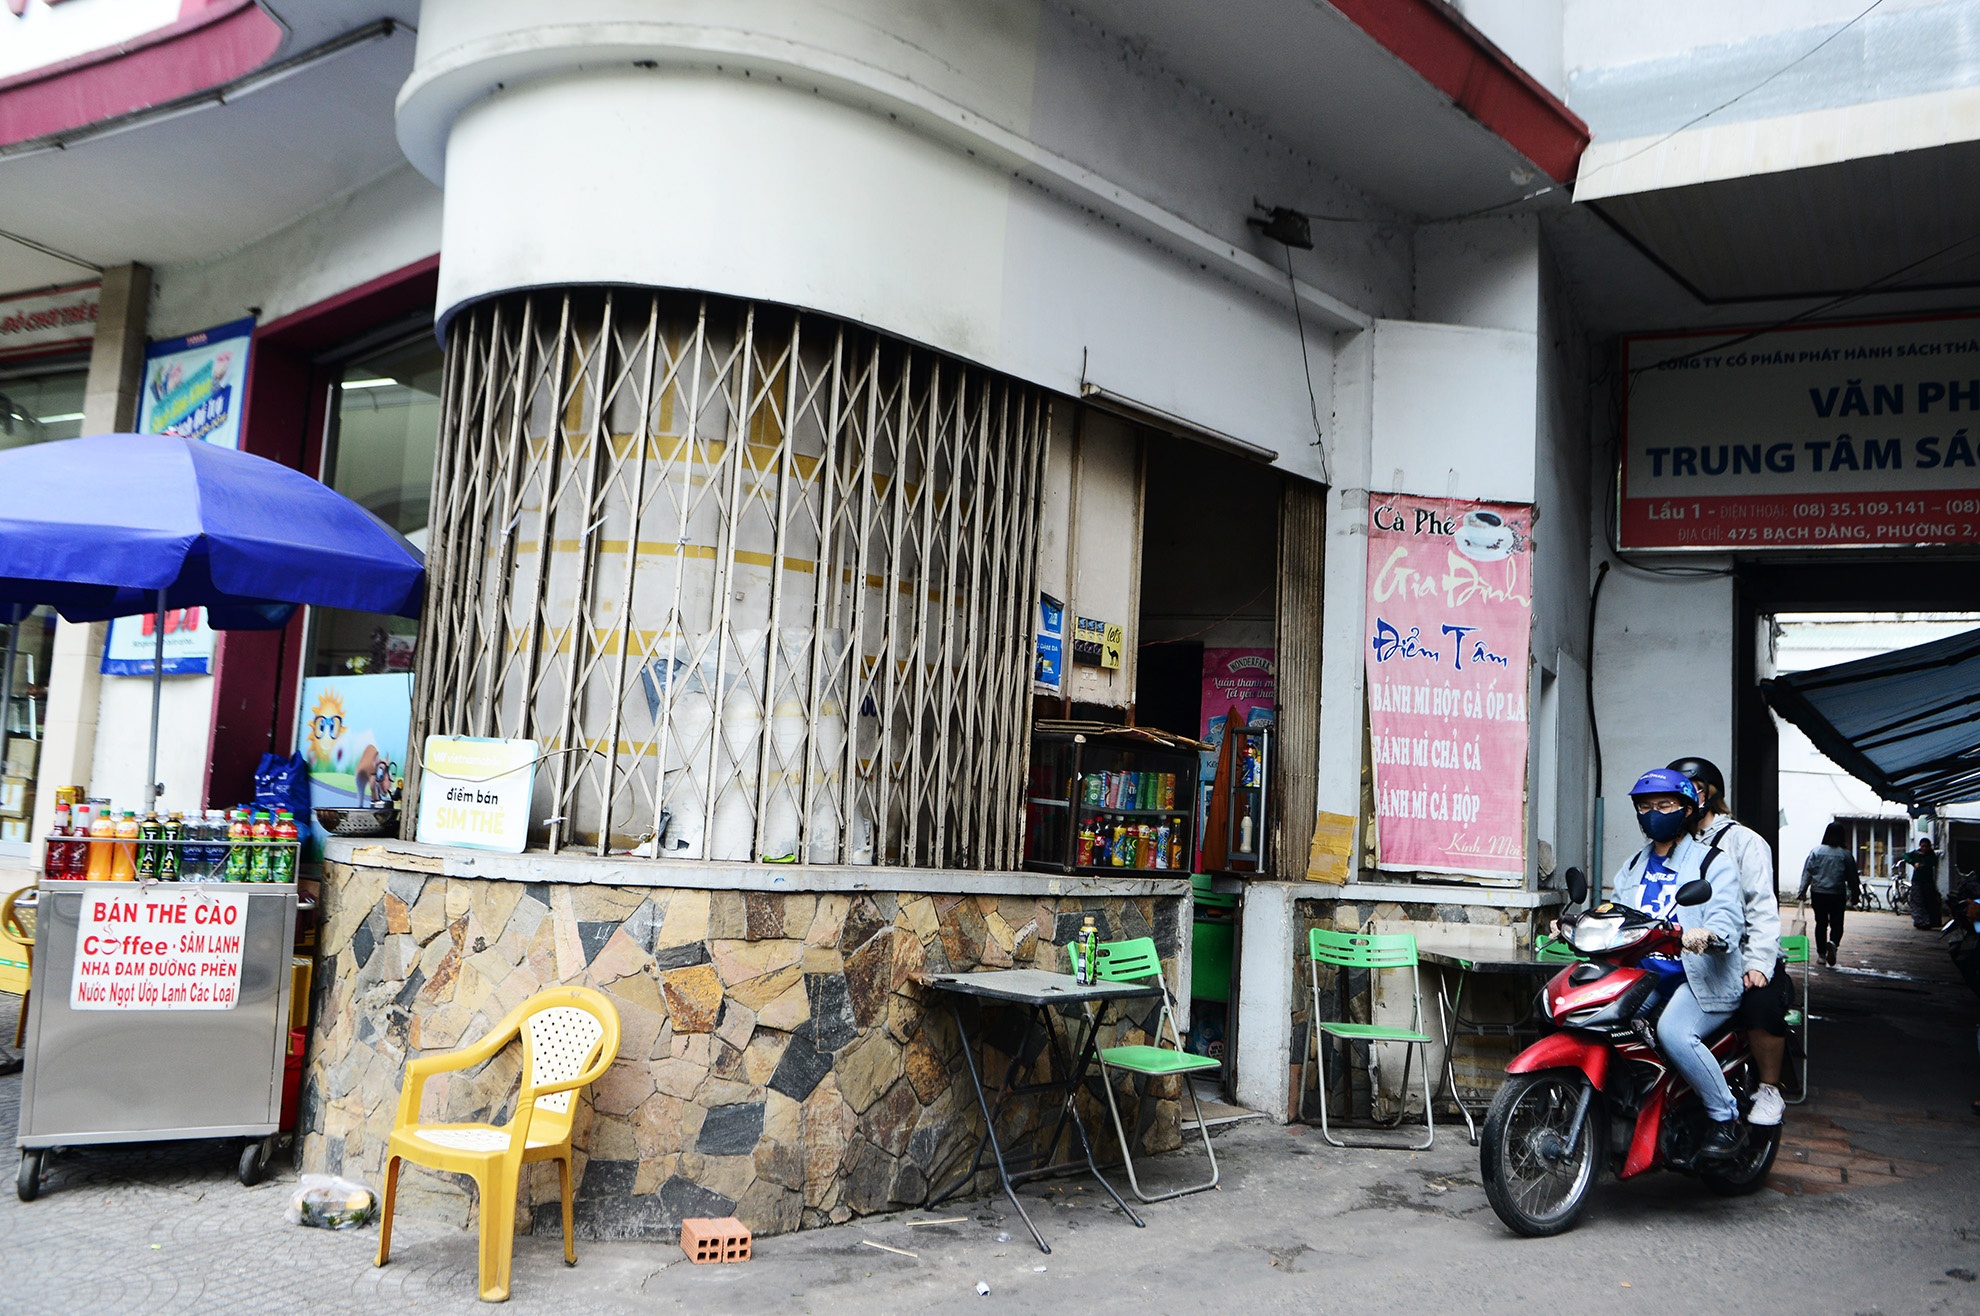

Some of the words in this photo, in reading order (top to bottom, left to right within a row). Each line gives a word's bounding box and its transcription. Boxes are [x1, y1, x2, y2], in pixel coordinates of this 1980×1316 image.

[1703, 357, 1722, 368] TY
[1897, 342, 1941, 357] SÁCH
[1808, 379, 1904, 418] VĂN
[1645, 442, 1795, 477] TRUNG
[1804, 433, 1902, 472] TÂM
[1915, 428, 1980, 469] SÁ
[1373, 505, 1406, 533] Cà
[1414, 508, 1457, 536] Phê
[1690, 503, 1700, 518] 1
[1792, 502, 1825, 518] (08)
[1830, 501, 1925, 516] 35.109.141
[1946, 499, 1980, 515] (08)
[1727, 527, 1758, 540] 475
[1763, 526, 1809, 542] BẠCH
[1877, 522, 1957, 538] PHƯỜNG
[1372, 617, 1439, 663] Điểm
[1441, 623, 1508, 671] Tâm
[1229, 657, 1272, 672] WONDERFAR
[1237, 677, 1262, 687] thanh
[1373, 675, 1411, 714] BÁNH
[1414, 679, 1430, 715] MÌ
[1433, 680, 1460, 723] HỘT
[1463, 682, 1483, 719] GÀ
[1486, 678, 1505, 720] ỐP
[1507, 693, 1526, 721] LA
[1413, 730, 1429, 767] MÌ
[1431, 728, 1460, 769] CHẢ
[1463, 734, 1482, 770] CÁ
[476, 789, 499, 805] bán
[1412, 782, 1428, 819] MÌ
[1430, 784, 1449, 821] CÁ
[1452, 785, 1480, 829] HỘP
[436, 806, 468, 831] SIM
[93, 896, 138, 923] BÁN
[146, 896, 188, 924] THẺ
[194, 899, 238, 925] CÀO
[208, 935, 240, 959] LẠNH
[81, 961, 110, 976] NHA
[115, 962, 145, 976] ĐAM
[200, 960, 237, 977] PHÈN
[78, 981, 106, 1002] Nước
[109, 982, 136, 1008] Ngọt
[162, 982, 187, 1008] Lạnh
[190, 982, 209, 1002] Các
[213, 982, 236, 1008] Loại
